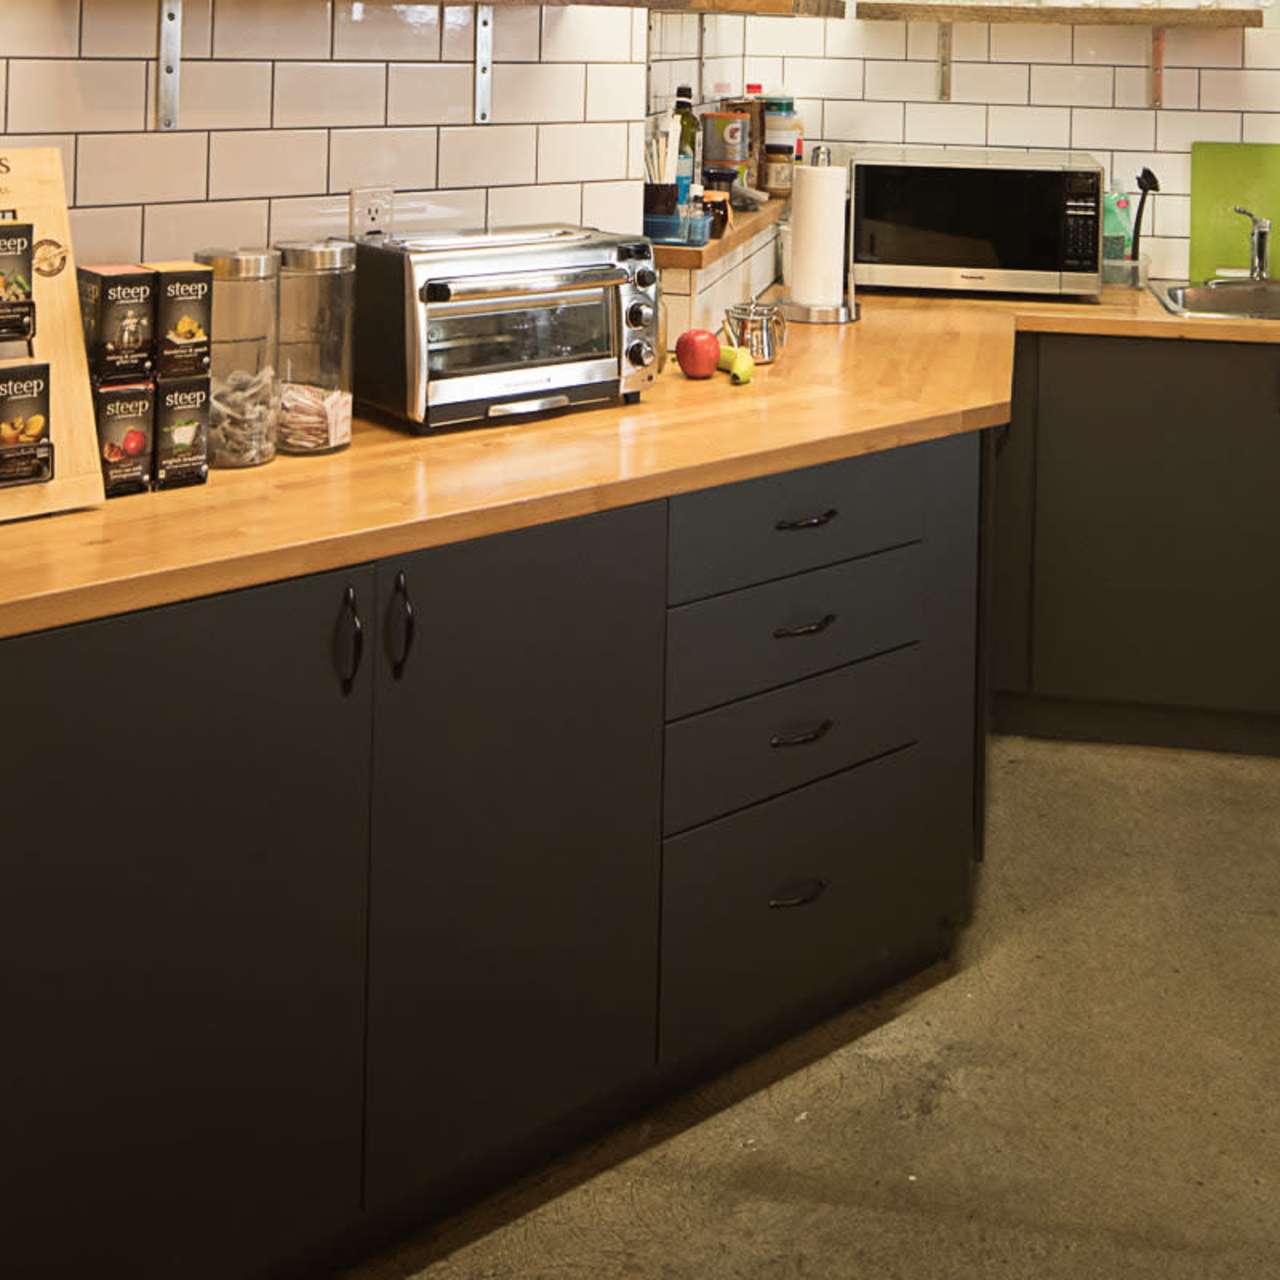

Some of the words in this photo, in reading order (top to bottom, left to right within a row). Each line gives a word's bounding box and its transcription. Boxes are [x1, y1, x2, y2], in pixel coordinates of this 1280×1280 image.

[108, 284, 151, 302] steep
[167, 281, 208, 299] steep
[0, 378, 45, 398] steep
[106, 399, 150, 416] steep
[166, 390, 207, 409] steep
